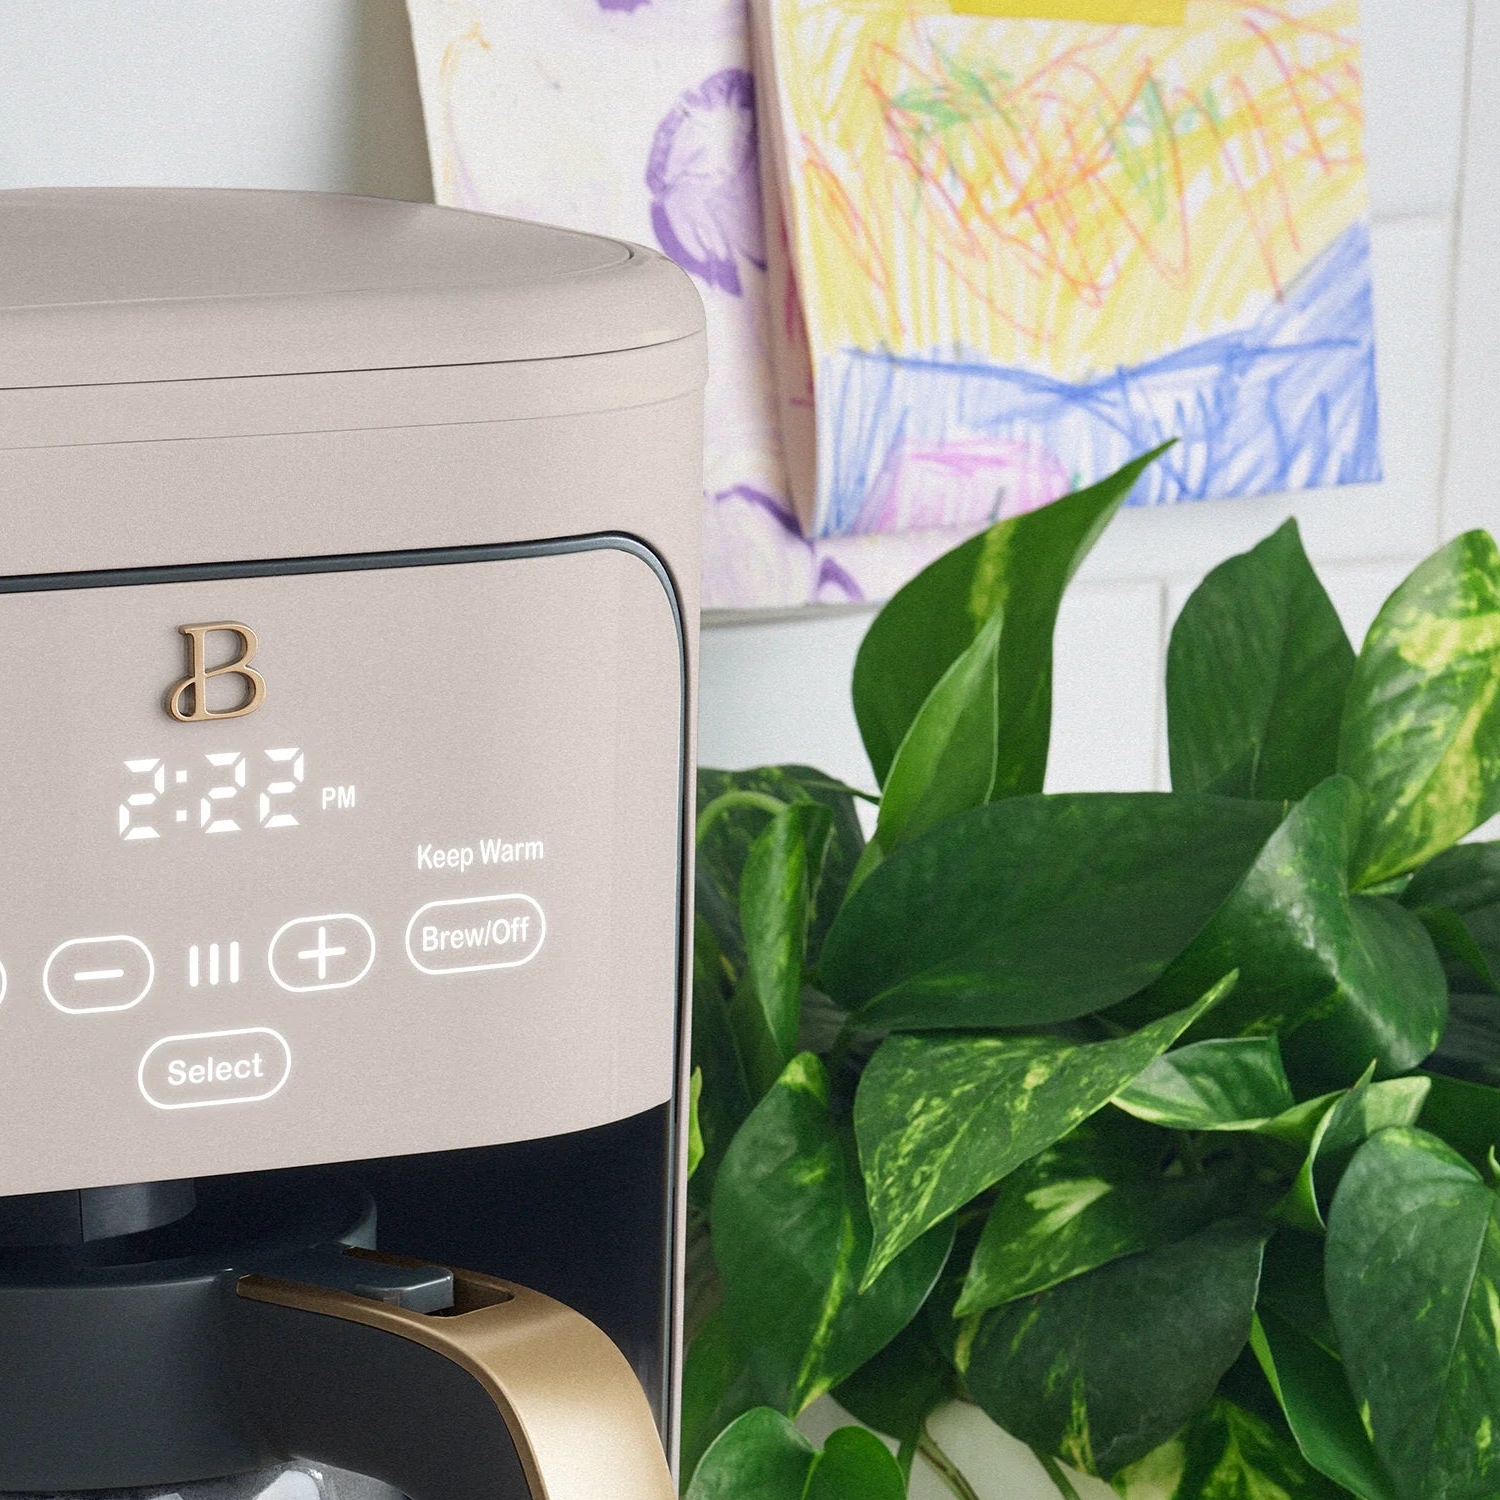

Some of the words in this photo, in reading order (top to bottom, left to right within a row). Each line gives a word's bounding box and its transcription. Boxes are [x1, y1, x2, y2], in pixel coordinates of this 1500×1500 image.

[119, 748, 304, 840] 2:22
[323, 785, 355, 809] PM
[418, 844, 473, 872] Keep
[480, 839, 543, 864] Warm
[422, 918, 531, 953] Brew/Off
[168, 1053, 263, 1085] Select
